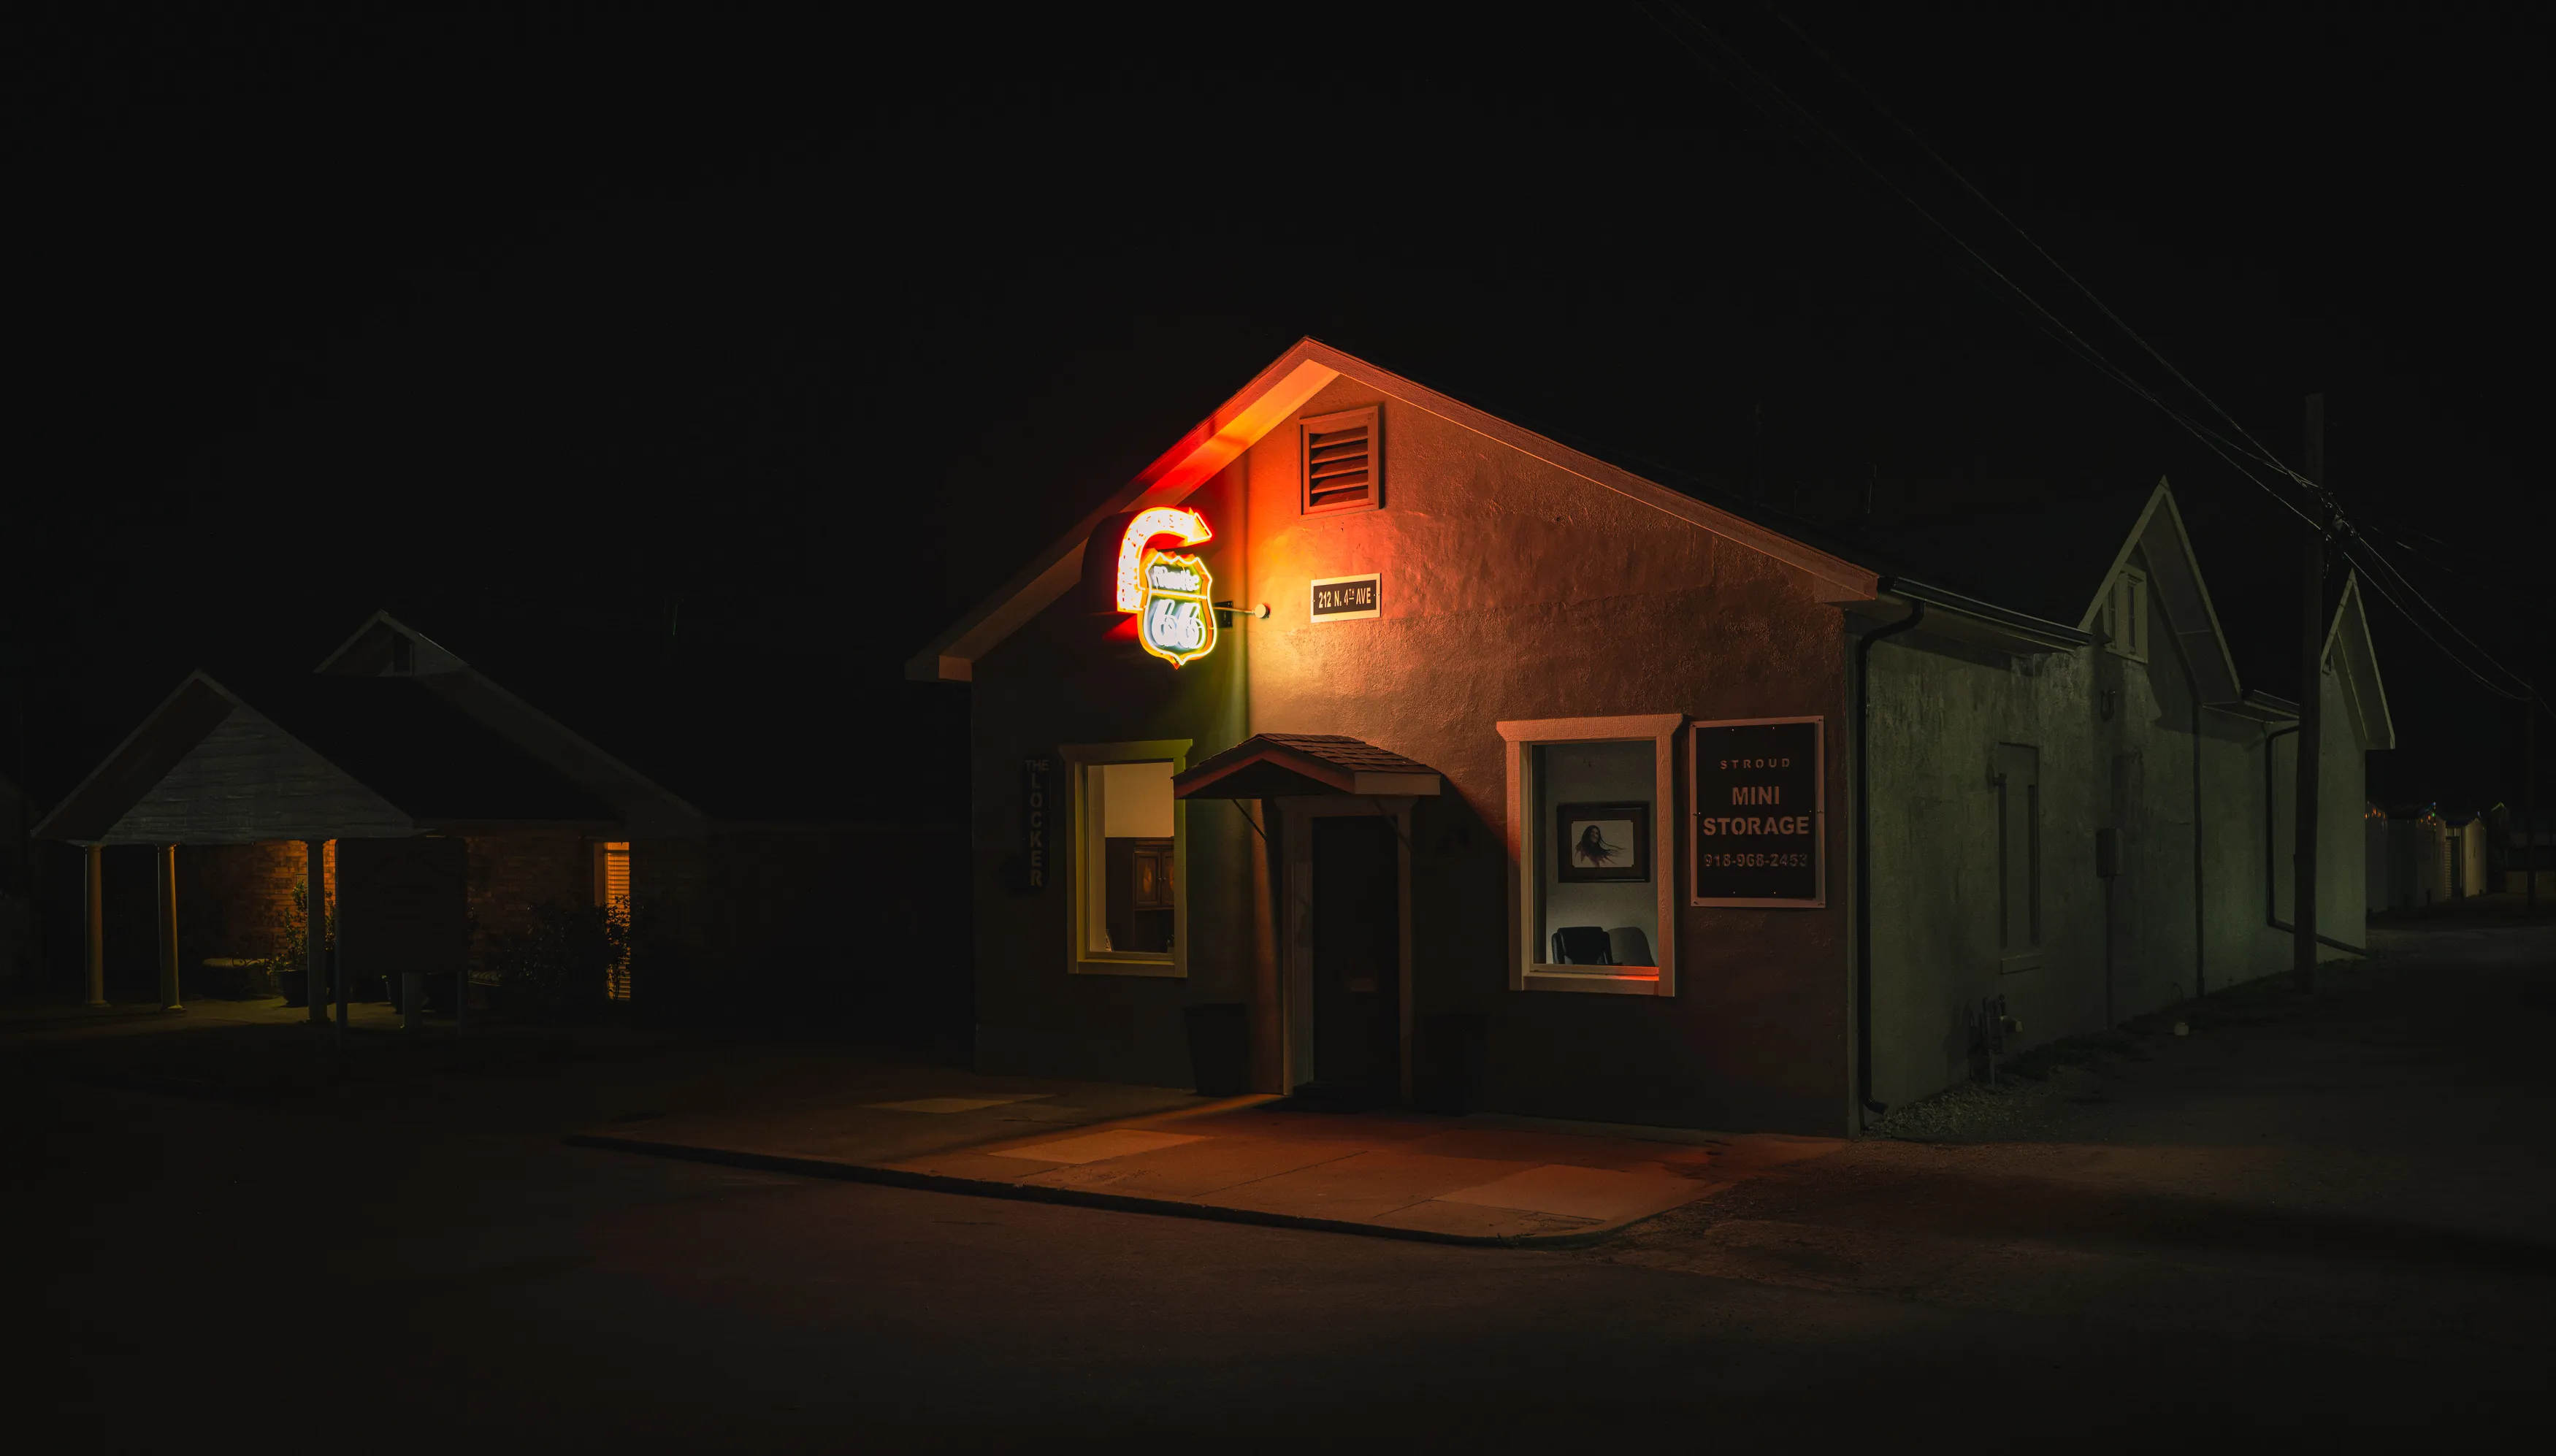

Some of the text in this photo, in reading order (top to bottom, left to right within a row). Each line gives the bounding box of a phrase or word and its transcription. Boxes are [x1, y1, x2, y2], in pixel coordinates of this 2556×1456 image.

[1317, 590, 1331, 608] 212
[1334, 590, 1342, 607] N.
[1355, 587, 1371, 605] AVE
[1152, 599, 1205, 649] 66
[1025, 759, 1049, 772] THE
[1720, 757, 1791, 770] STROUD
[1732, 786, 1780, 805] MINI
[1029, 772, 1044, 888] LOCKER
[1702, 816, 1810, 836] STORAGE
[1703, 853, 1808, 867] 918-968-2453
